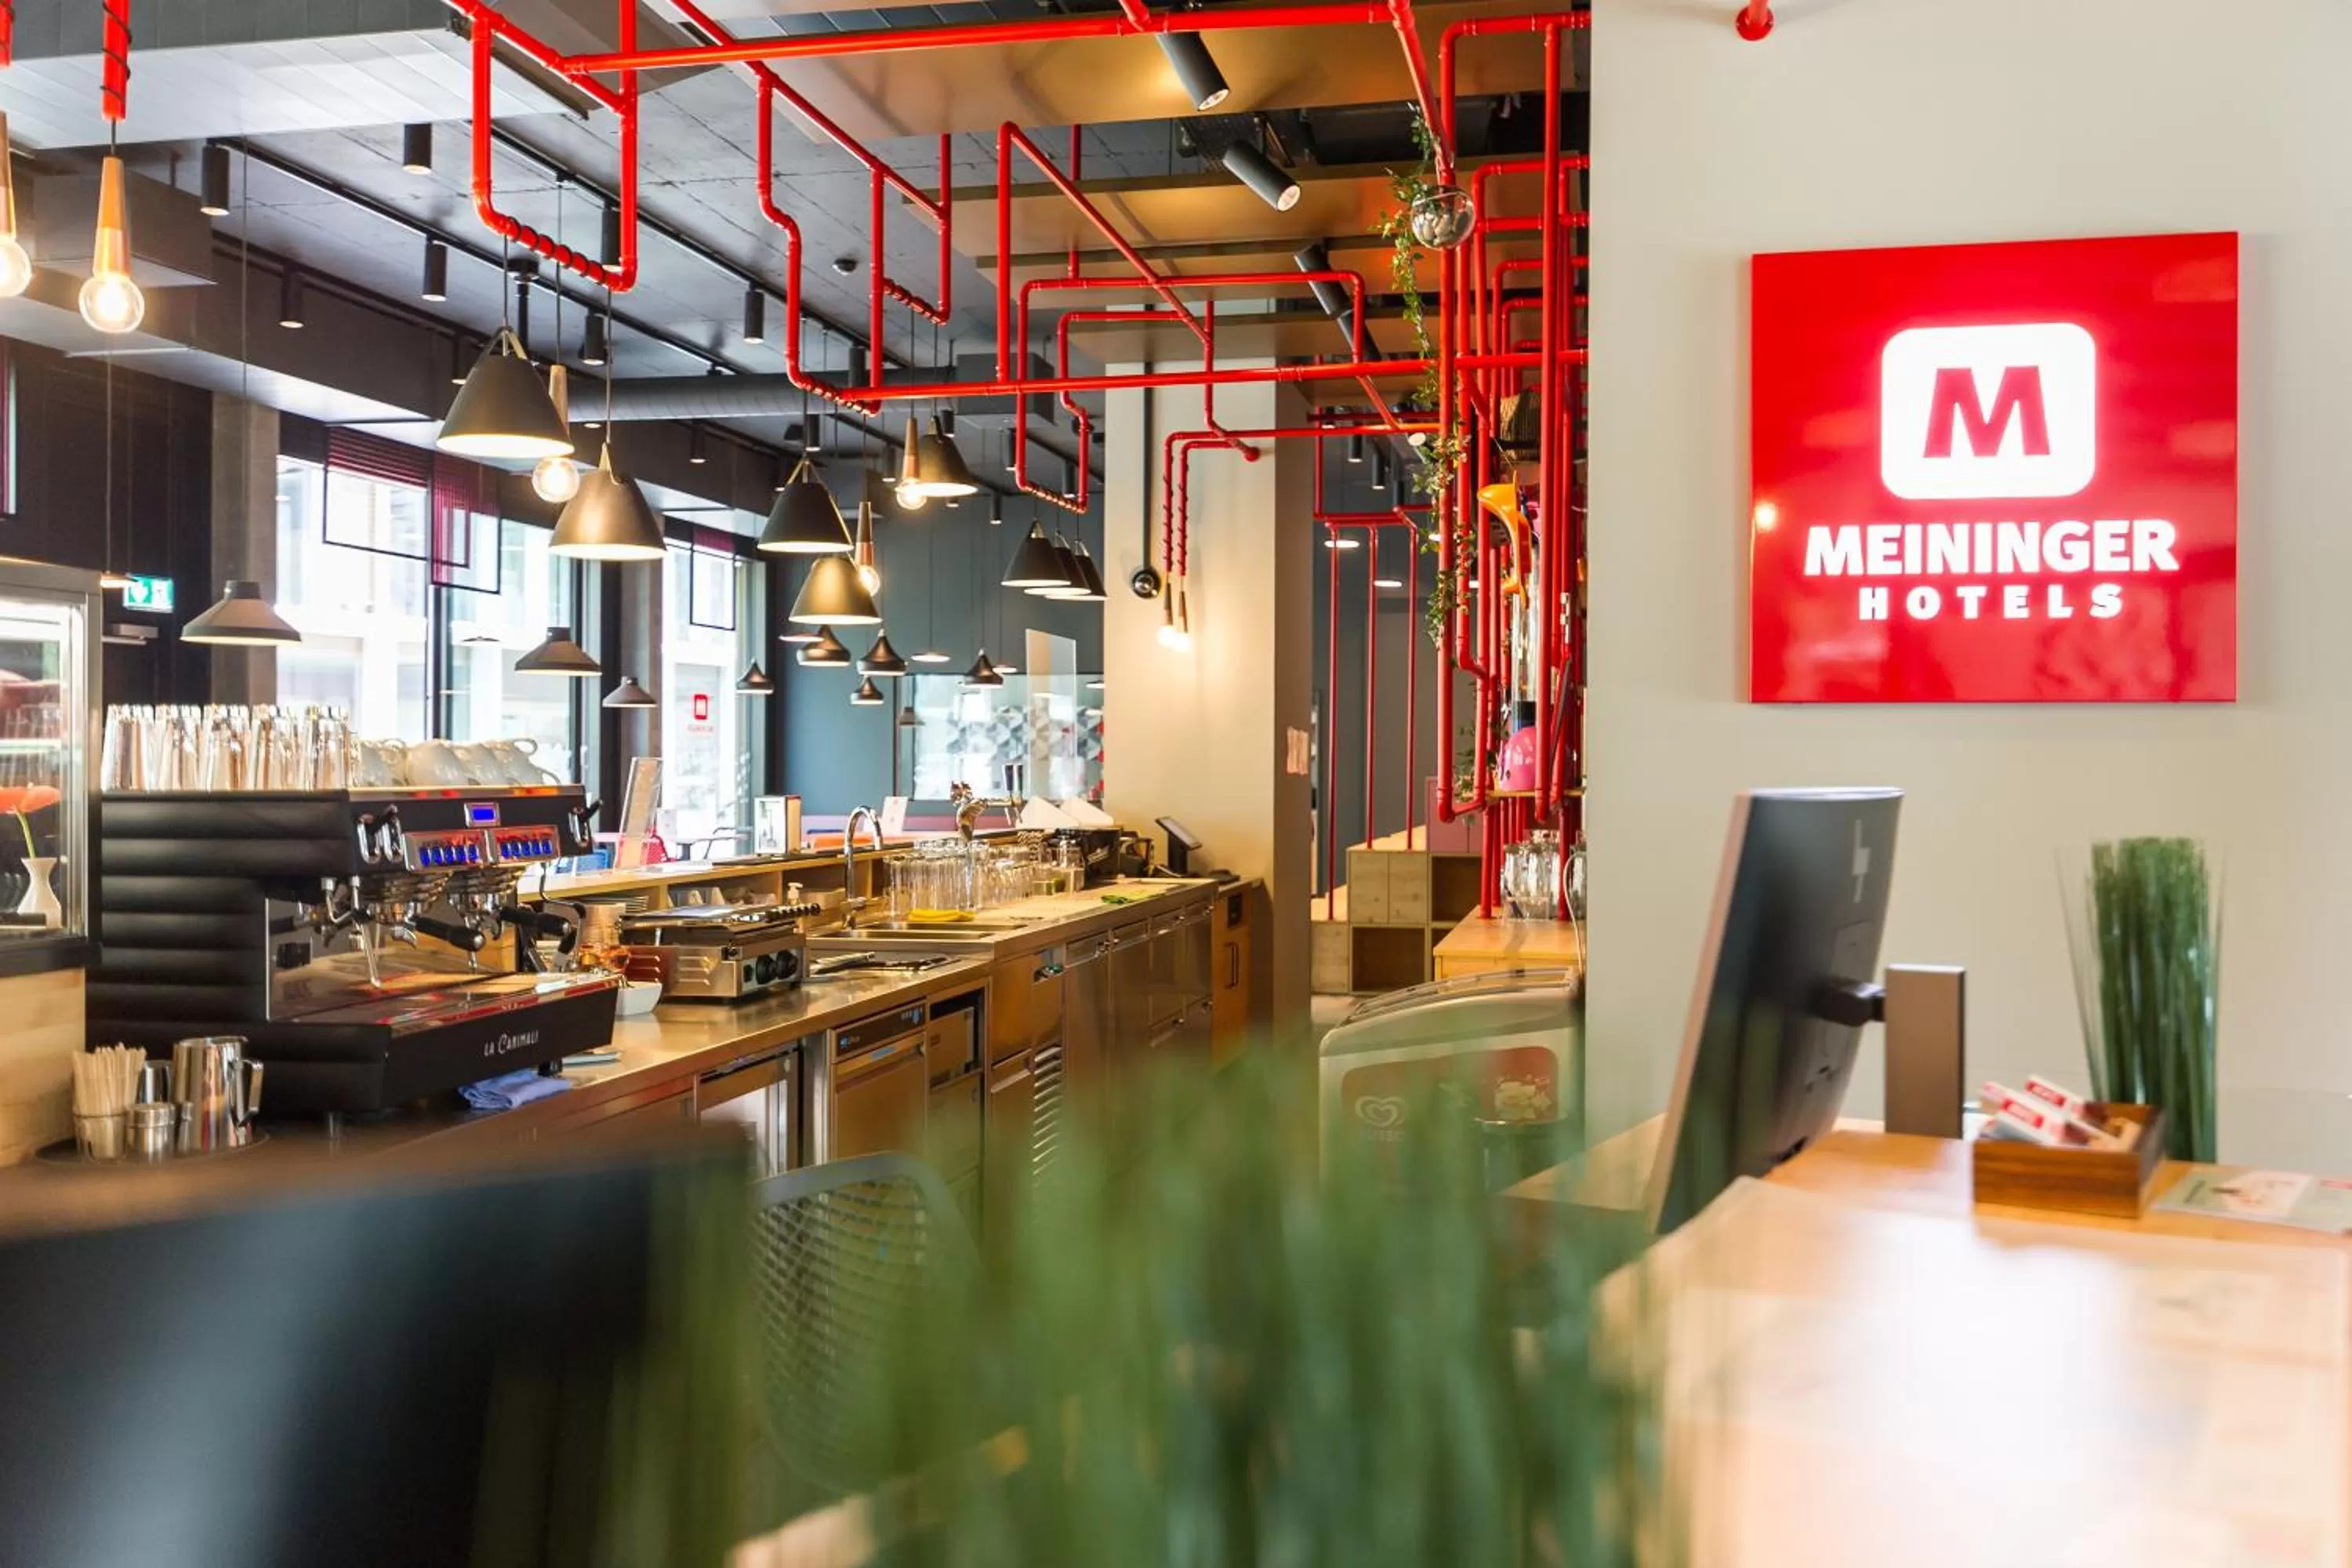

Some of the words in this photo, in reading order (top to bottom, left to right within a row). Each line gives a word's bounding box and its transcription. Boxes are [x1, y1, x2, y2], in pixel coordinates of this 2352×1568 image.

[1923, 365, 2051, 459] M
[1804, 518, 2180, 577] MEININGER
[1858, 583, 2124, 621] HOTELS
